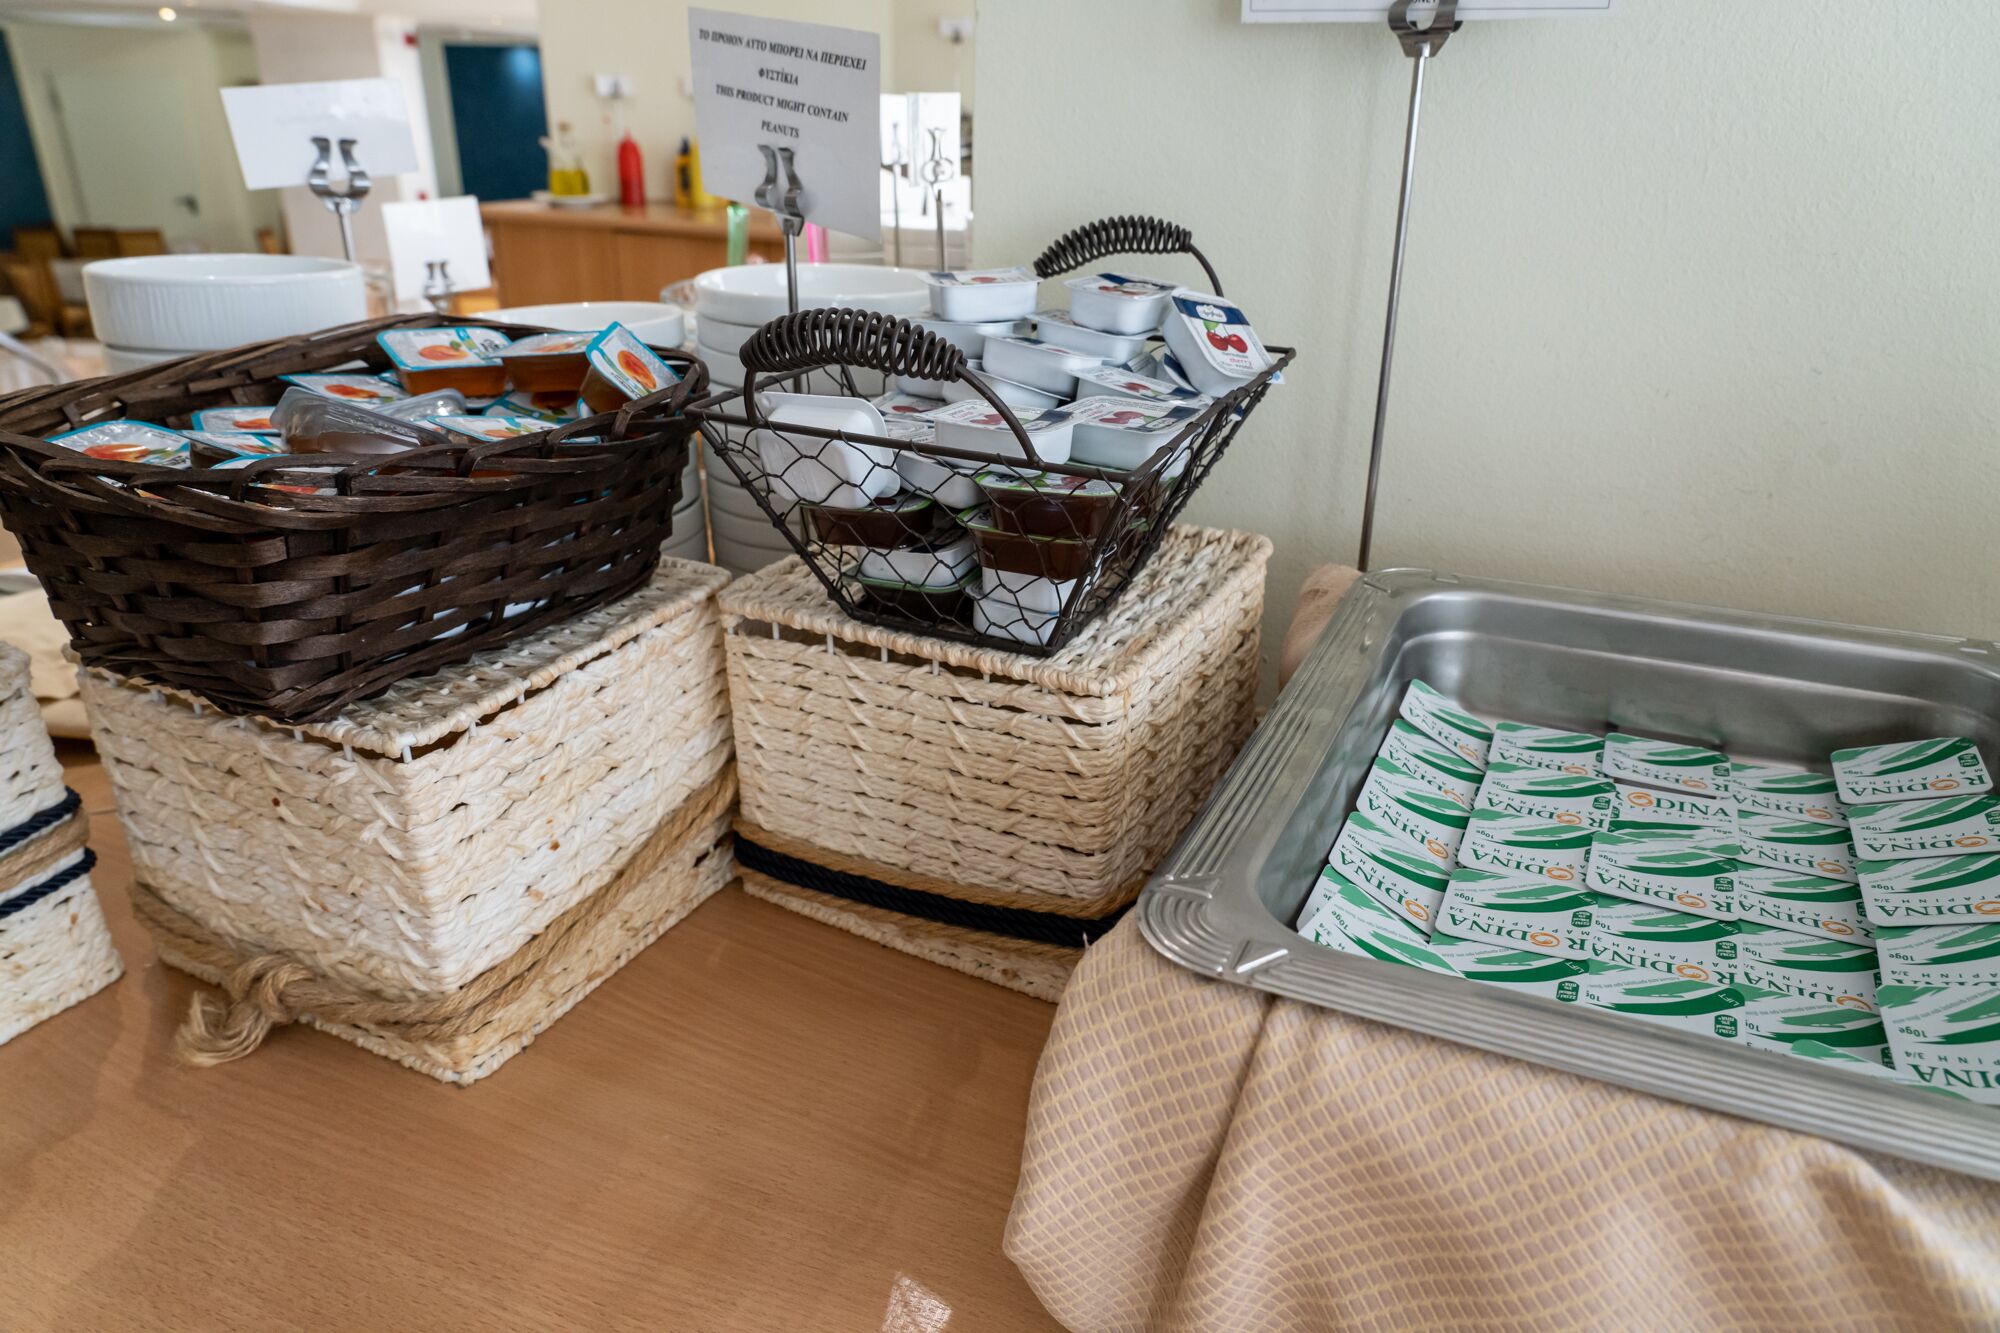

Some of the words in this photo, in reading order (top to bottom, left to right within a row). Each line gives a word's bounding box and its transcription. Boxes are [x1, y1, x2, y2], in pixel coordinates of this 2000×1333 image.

[699, 29, 710, 40] ΤΟ
[744, 38, 767, 52] ΑΥΤΟ
[769, 42, 804, 59] ΜΠΟΡΕΙ
[806, 49, 818, 62] ΝΑ
[820, 52, 867, 71] ΠΕΡΙΕΧΕΙ
[716, 84, 734, 98] THIS
[736, 89, 775, 106] PRODUCT
[777, 98, 806, 114] MIGHT
[807, 105, 849, 123] CONTAIN
[761, 120, 800, 138] PEANUTS
[1594, 871, 1734, 914] RODINA
[1447, 913, 1588, 952] RODINA
